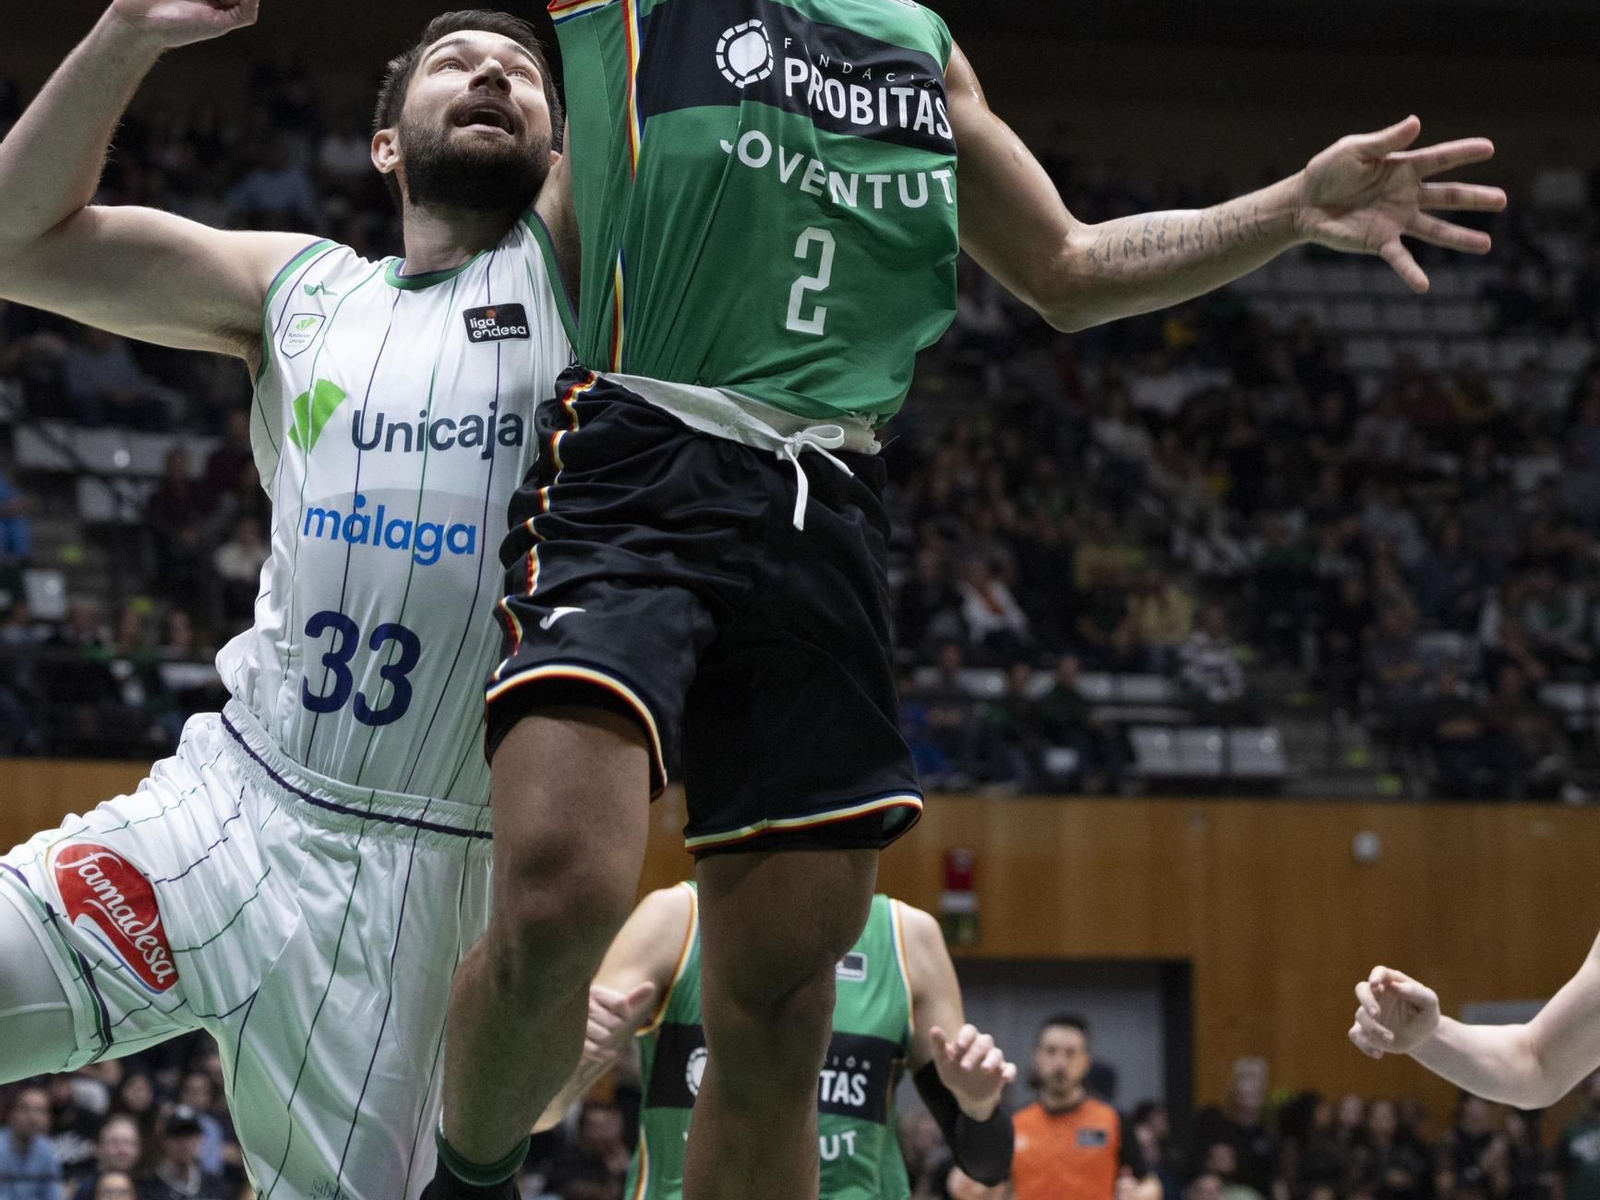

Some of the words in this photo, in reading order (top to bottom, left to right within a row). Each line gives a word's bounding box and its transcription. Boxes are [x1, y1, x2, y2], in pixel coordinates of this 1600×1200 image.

[784, 56, 953, 140] PROBITAS
[786, 226, 836, 336] 2
[470, 317, 496, 329] liga
[473, 325, 527, 339] endesa
[351, 402, 523, 461] Unicaja
[303, 495, 477, 566] málaga
[302, 610, 422, 727] 33
